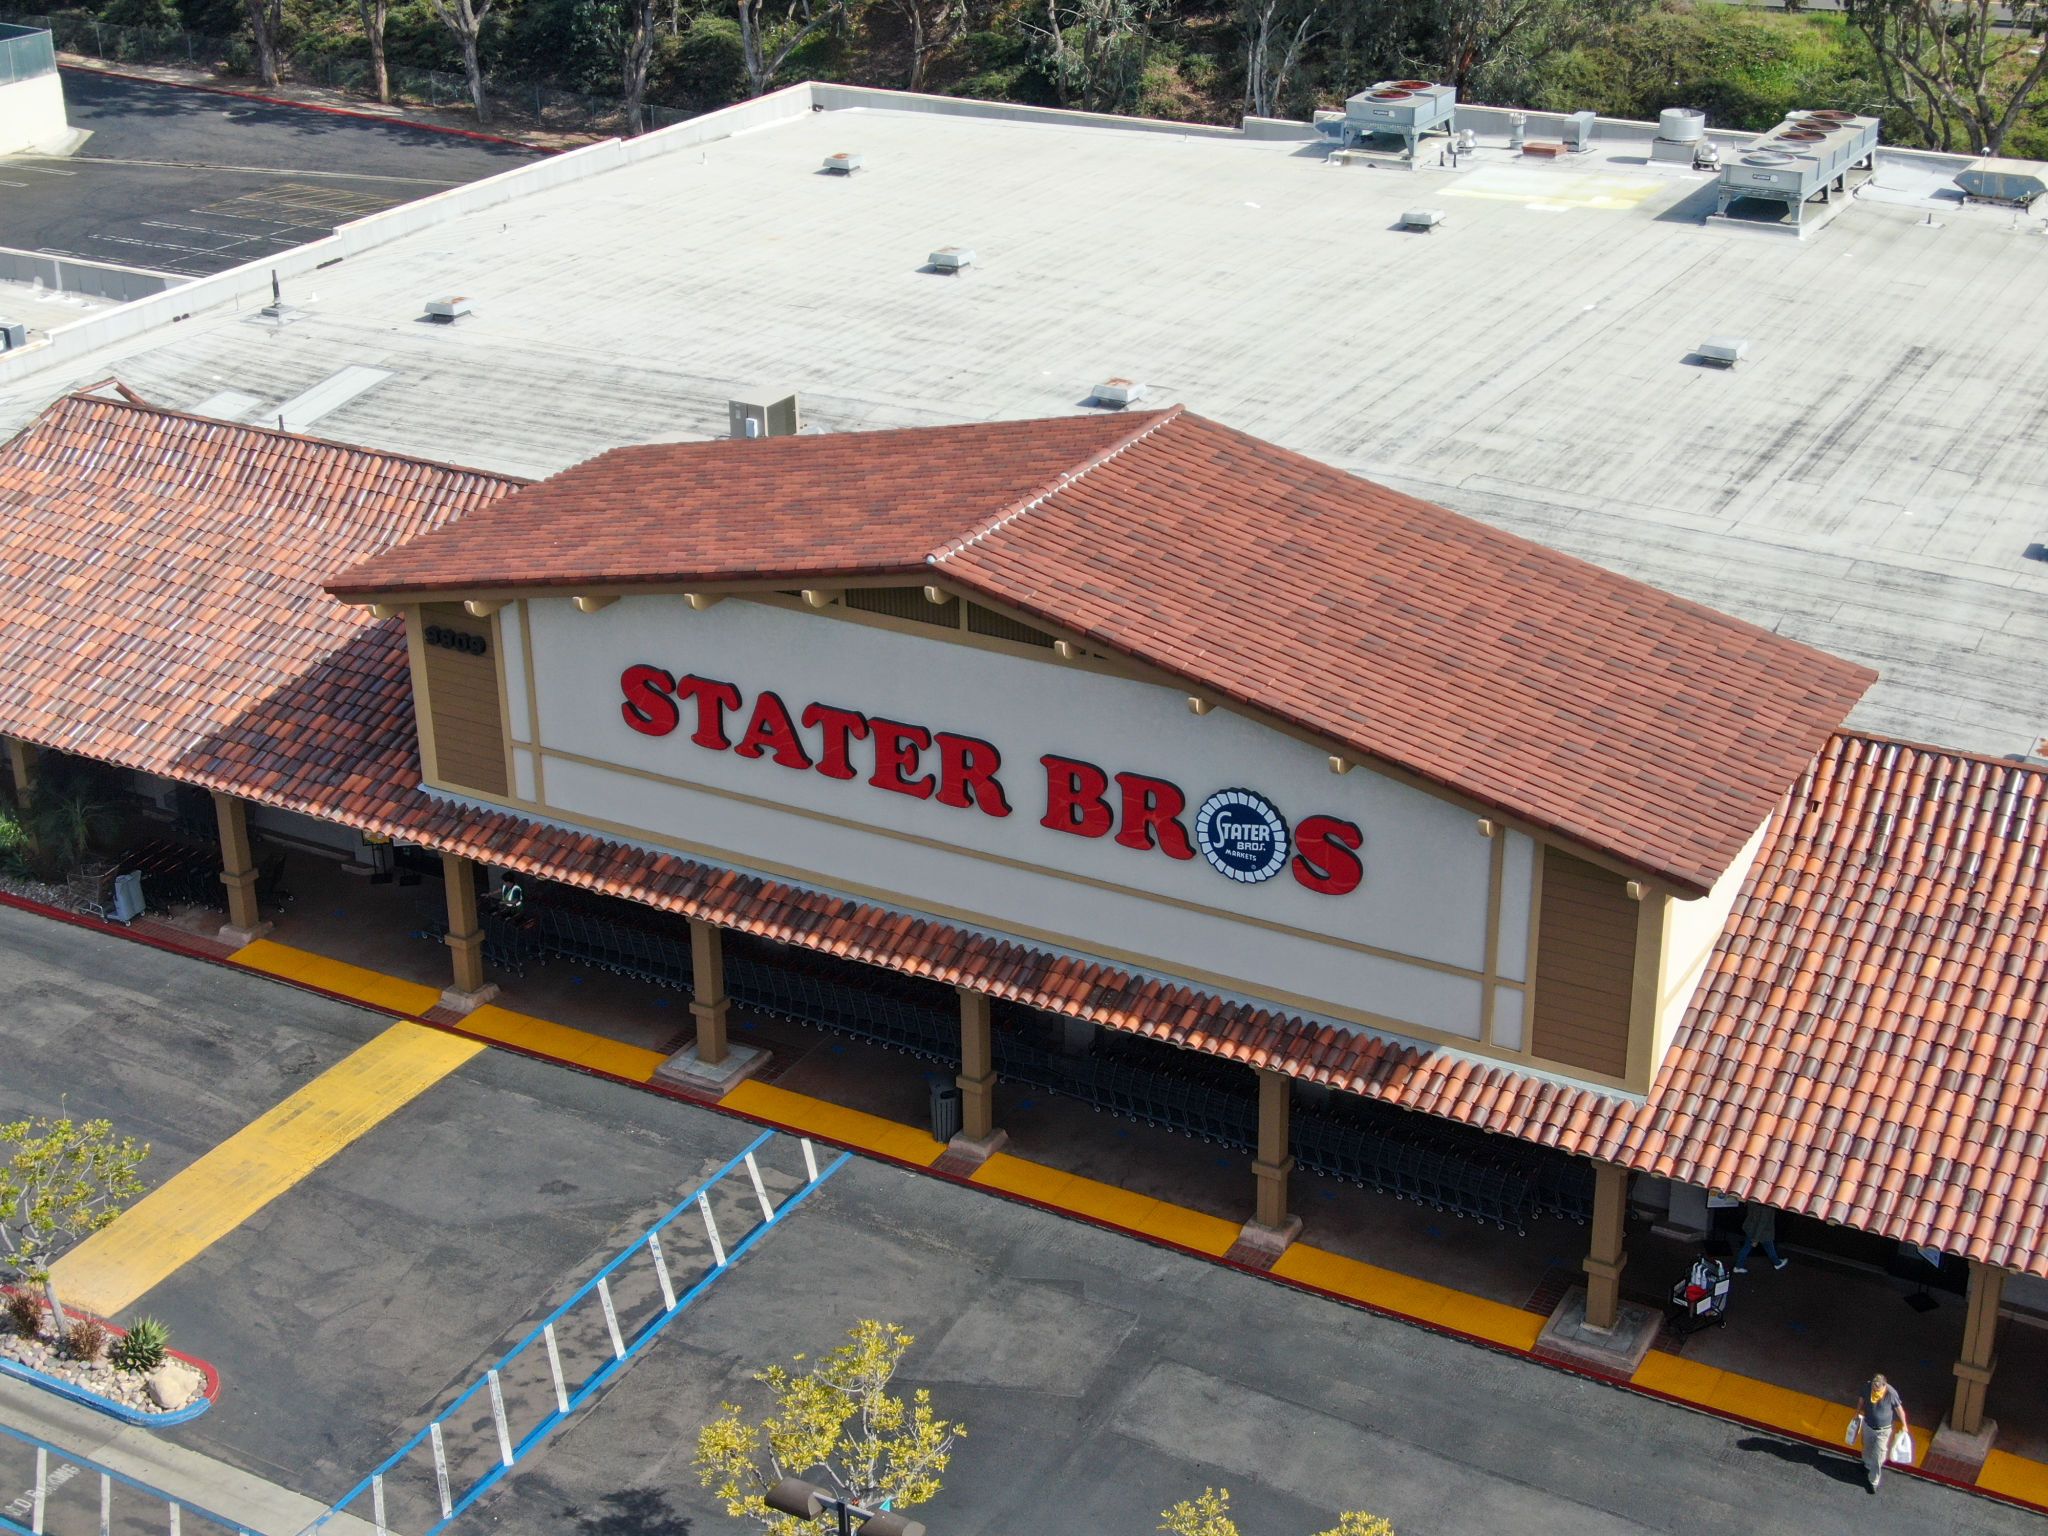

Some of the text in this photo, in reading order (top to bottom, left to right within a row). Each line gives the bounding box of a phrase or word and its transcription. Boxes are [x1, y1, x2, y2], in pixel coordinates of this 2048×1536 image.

[621, 664, 1013, 818] STATER
[1213, 811, 1270, 849] STATER
[1225, 849, 1257, 861] MARKETS
[24, 1463, 80, 1504] PRKING
